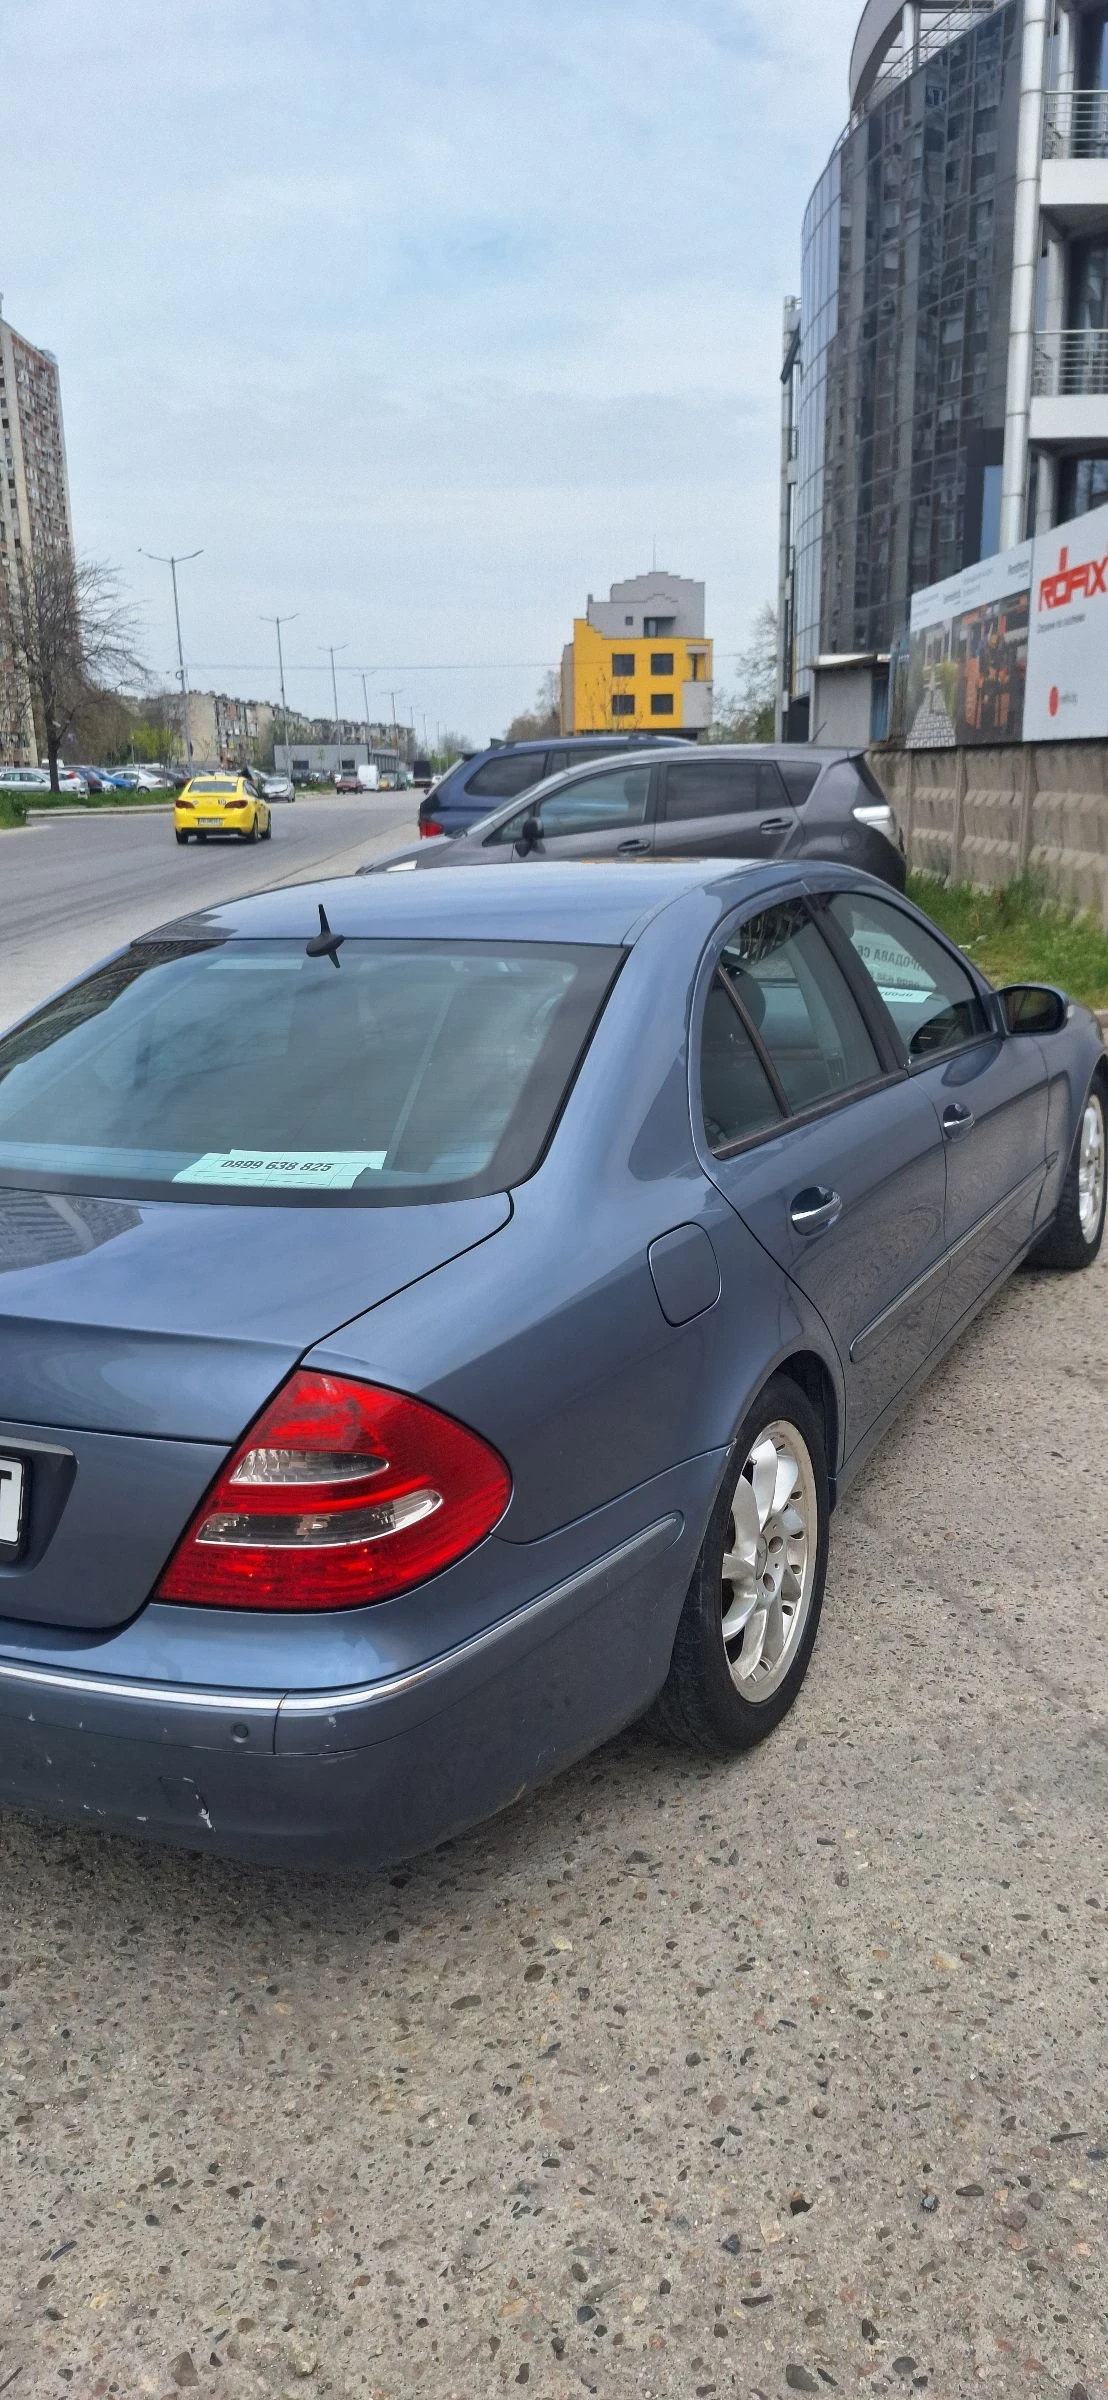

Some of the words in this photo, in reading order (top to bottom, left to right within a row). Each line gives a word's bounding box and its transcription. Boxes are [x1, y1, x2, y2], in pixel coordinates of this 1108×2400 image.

[221, 1160, 264, 1169] 0899
[265, 1161, 299, 1171] 638
[299, 1162, 335, 1172] 825
